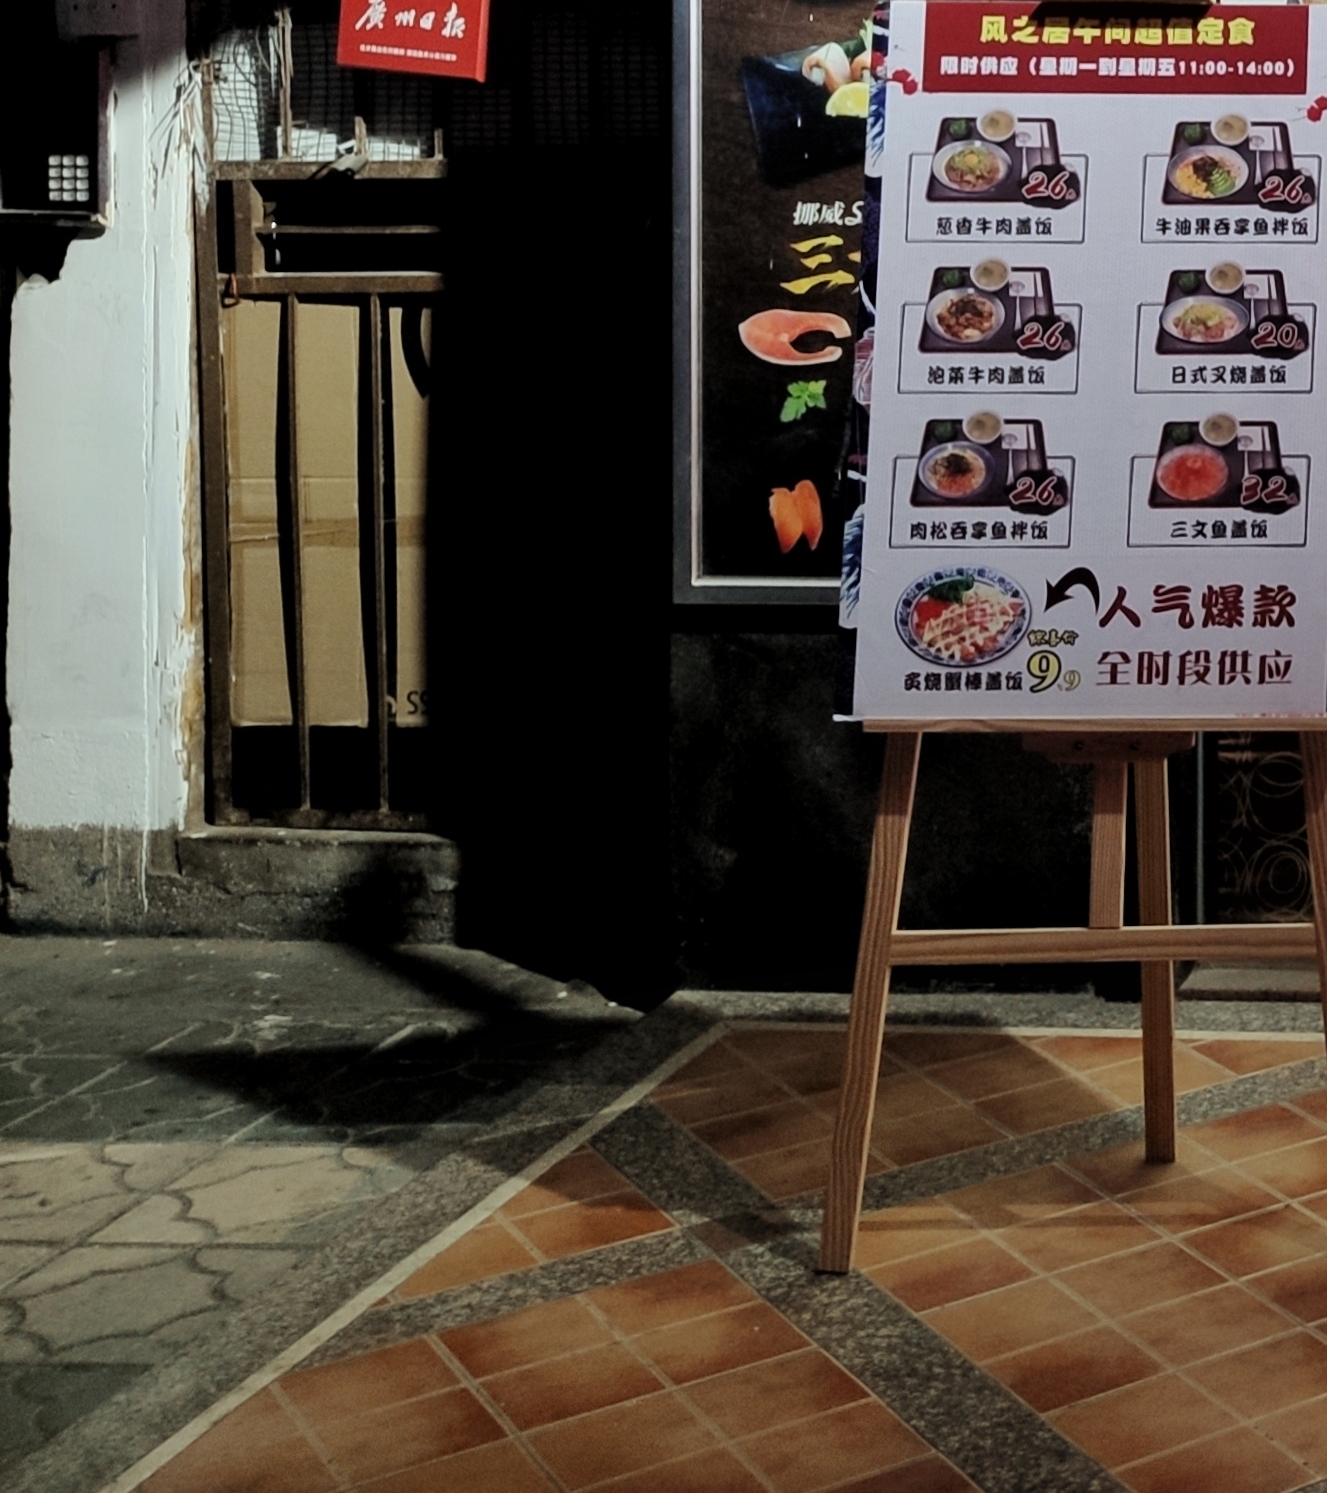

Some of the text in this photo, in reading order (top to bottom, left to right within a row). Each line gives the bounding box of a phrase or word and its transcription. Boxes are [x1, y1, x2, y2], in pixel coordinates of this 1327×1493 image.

[979, 14, 1258, 47] 风之居午间超值定食
[1021, 170, 1069, 200] 26
[1256, 174, 1304, 204] 26
[935, 216, 1054, 238] 葱香牛肉盖饭
[1154, 216, 1310, 238] 牛油果吞拿鱼拌饭
[1016, 321, 1064, 352] 26
[1250, 322, 1299, 351] 20
[927, 364, 1046, 386] 泡菜牛肉盖饭
[1170, 364, 1288, 386] 日式叉烧盖饭
[1008, 475, 1056, 506] 26
[1240, 475, 1290, 506] 32
[909, 520, 1050, 542] 肉松吞拿鱼拌饭
[1169, 520, 1269, 541] 三文鱼盖饭
[1098, 584, 1299, 629] 人气爆款
[903, 670, 1025, 693] 炙烧蟹棒盖饭
[1095, 649, 1294, 688] 全时段供应
